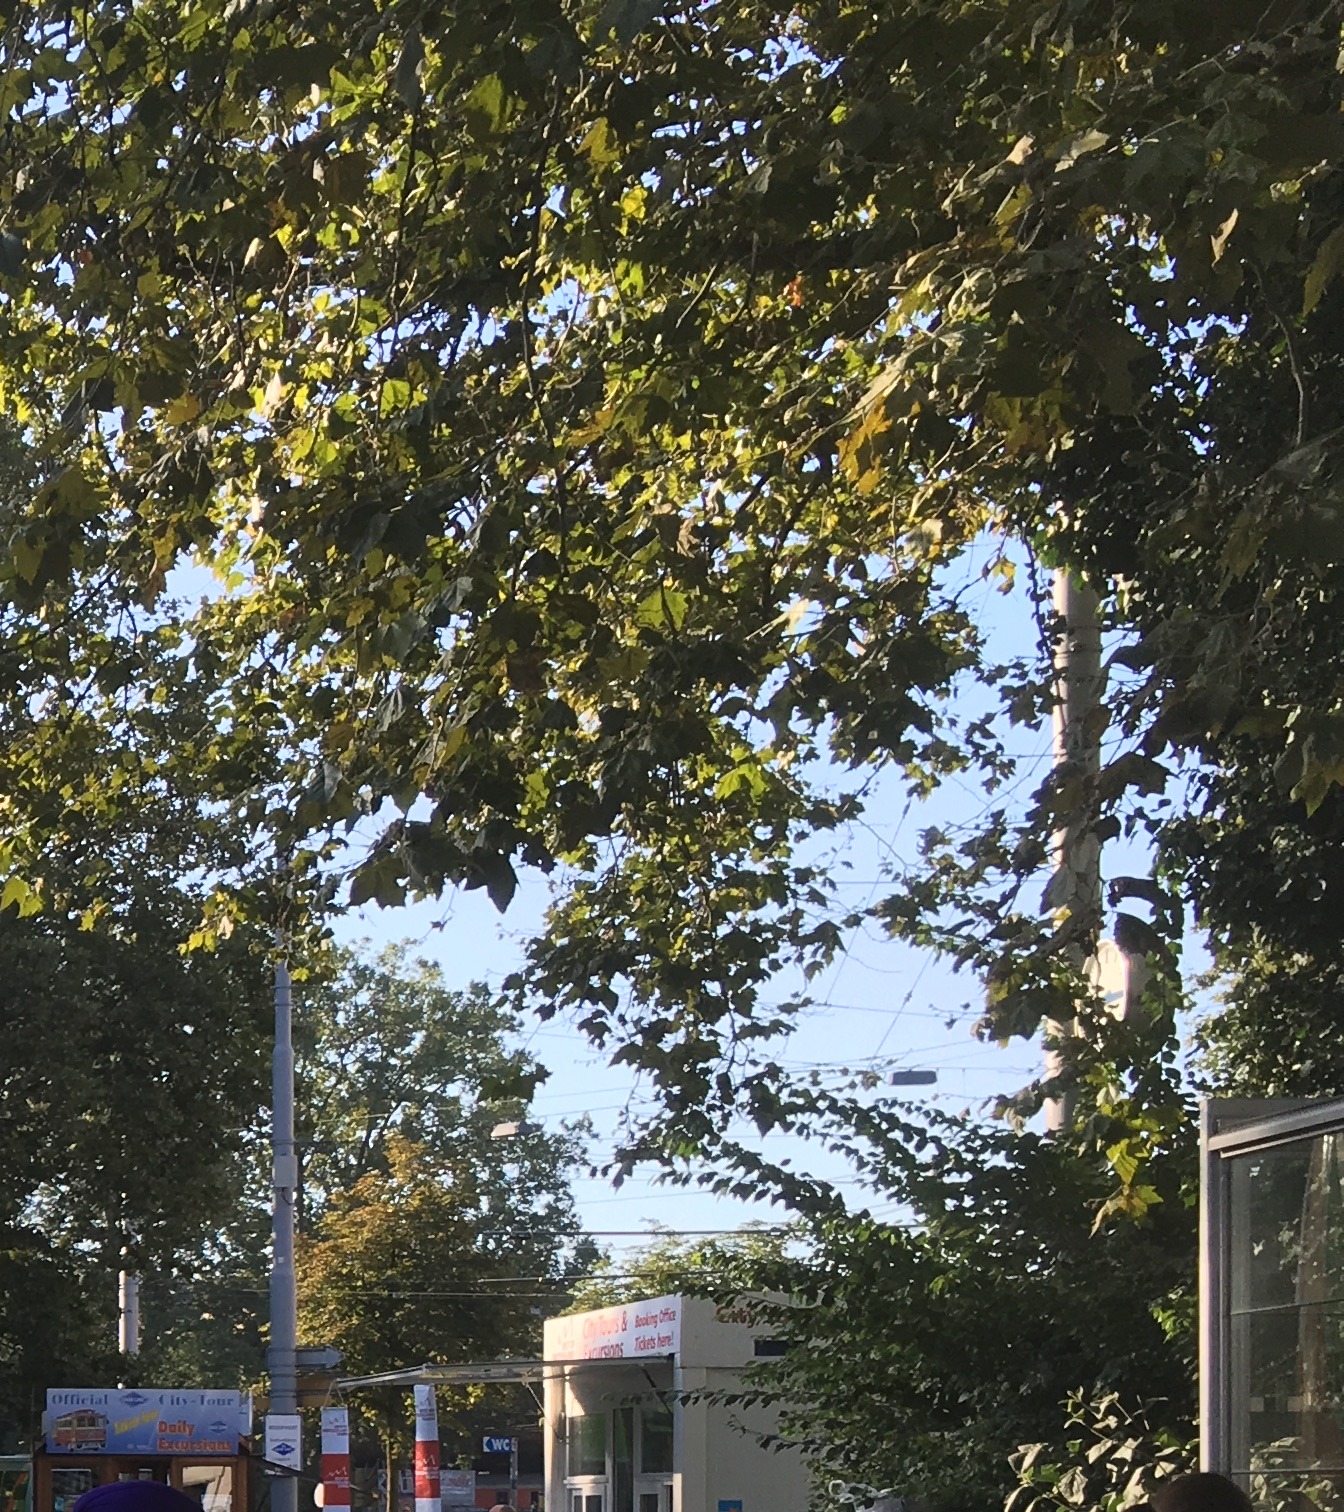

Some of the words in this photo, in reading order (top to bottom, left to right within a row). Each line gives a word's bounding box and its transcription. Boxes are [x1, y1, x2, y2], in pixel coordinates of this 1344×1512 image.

[621, 1310, 628, 1333] &
[634, 1312, 658, 1330] Booking
[659, 1307, 677, 1324] Office
[634, 1333, 657, 1352] Tickets
[658, 1330, 675, 1348] here!
[51, 1393, 109, 1406] Official
[157, 1419, 195, 1437] Daily
[157, 1436, 232, 1452] Excursions
[491, 1438, 510, 1451] WC
